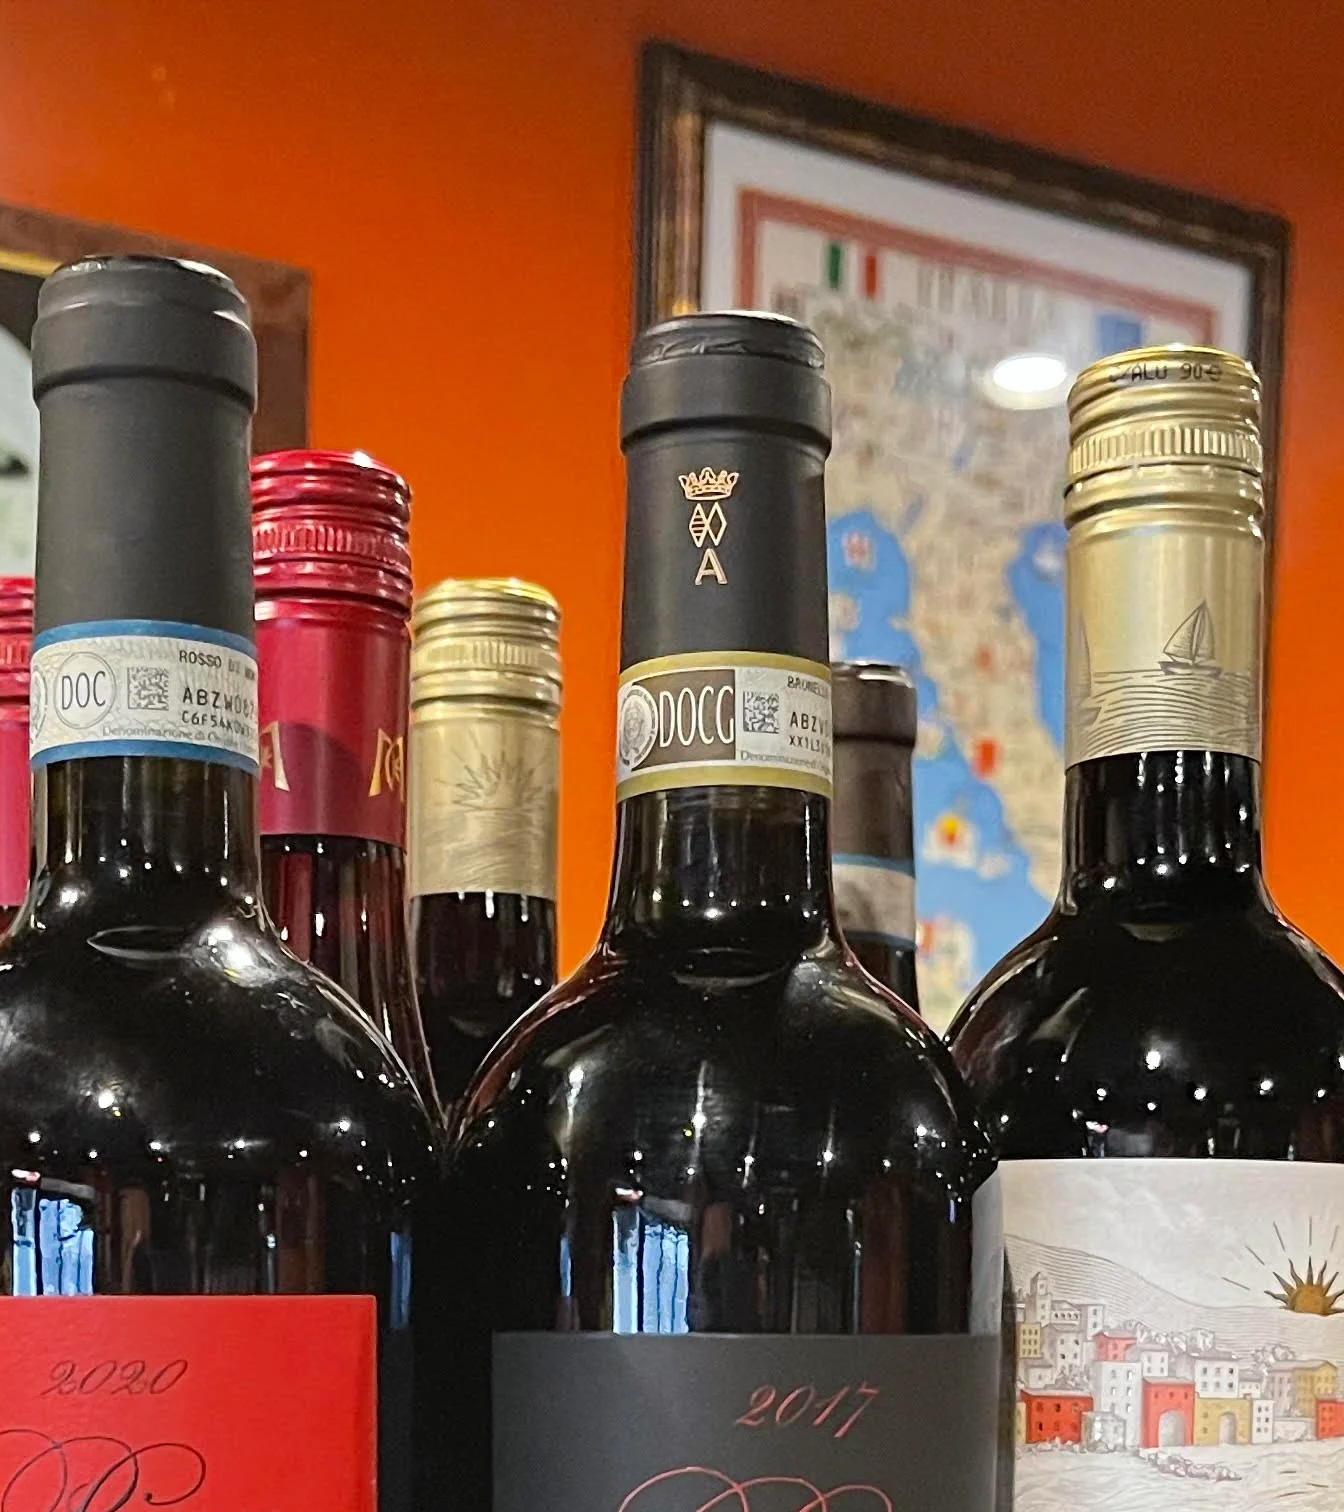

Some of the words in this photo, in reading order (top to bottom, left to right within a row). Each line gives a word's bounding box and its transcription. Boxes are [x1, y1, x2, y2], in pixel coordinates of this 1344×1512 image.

[178, 650, 222, 669] ROSSO
[62, 671, 106, 710] DOC
[659, 686, 734, 747] DOCG
[41, 1359, 189, 1396] 2020
[735, 1381, 880, 1437] 2017
